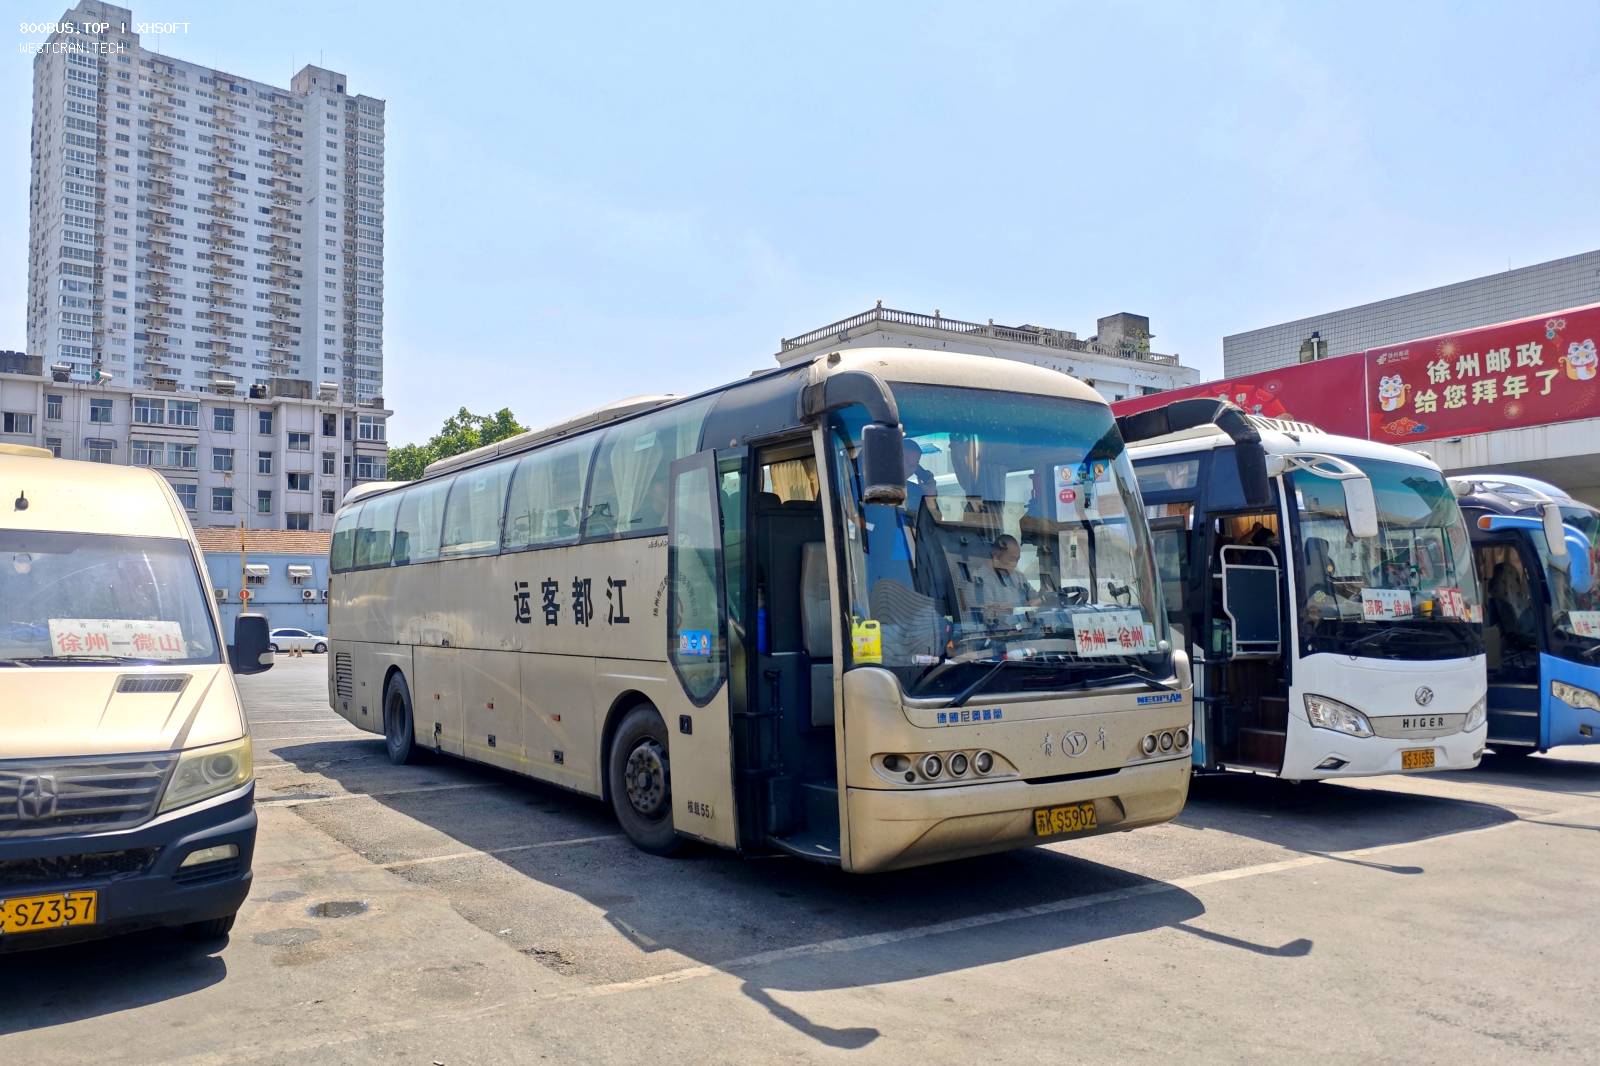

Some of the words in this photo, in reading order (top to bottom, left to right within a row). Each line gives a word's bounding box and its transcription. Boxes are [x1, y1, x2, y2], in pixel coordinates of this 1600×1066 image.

[1426, 341, 1544, 385] 徐州邮政
[1413, 369, 1559, 414] 给您拜年了
[1402, 717, 1445, 728] HIGER
